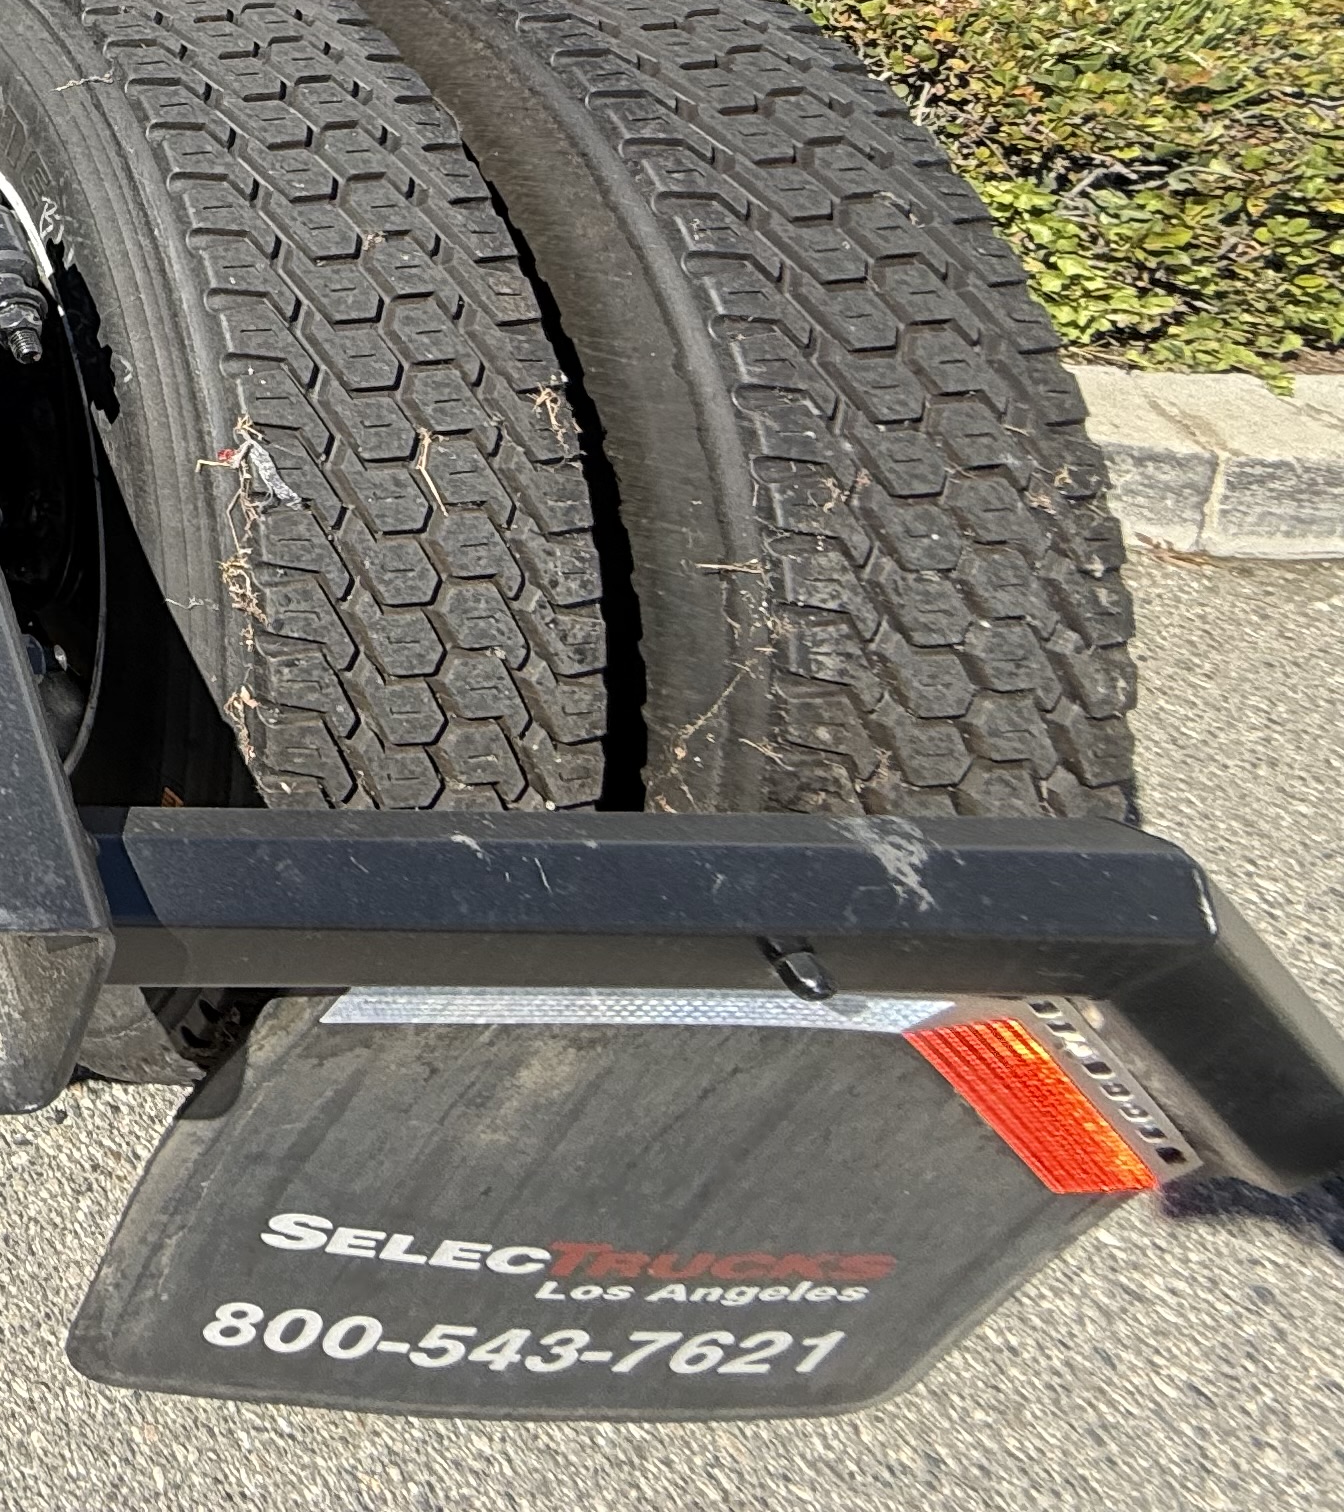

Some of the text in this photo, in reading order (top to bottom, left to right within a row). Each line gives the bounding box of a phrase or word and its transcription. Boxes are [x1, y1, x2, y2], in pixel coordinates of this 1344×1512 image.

[534, 1280, 871, 1306] Los Angeles
[202, 1301, 846, 1374] 800-543-7621
